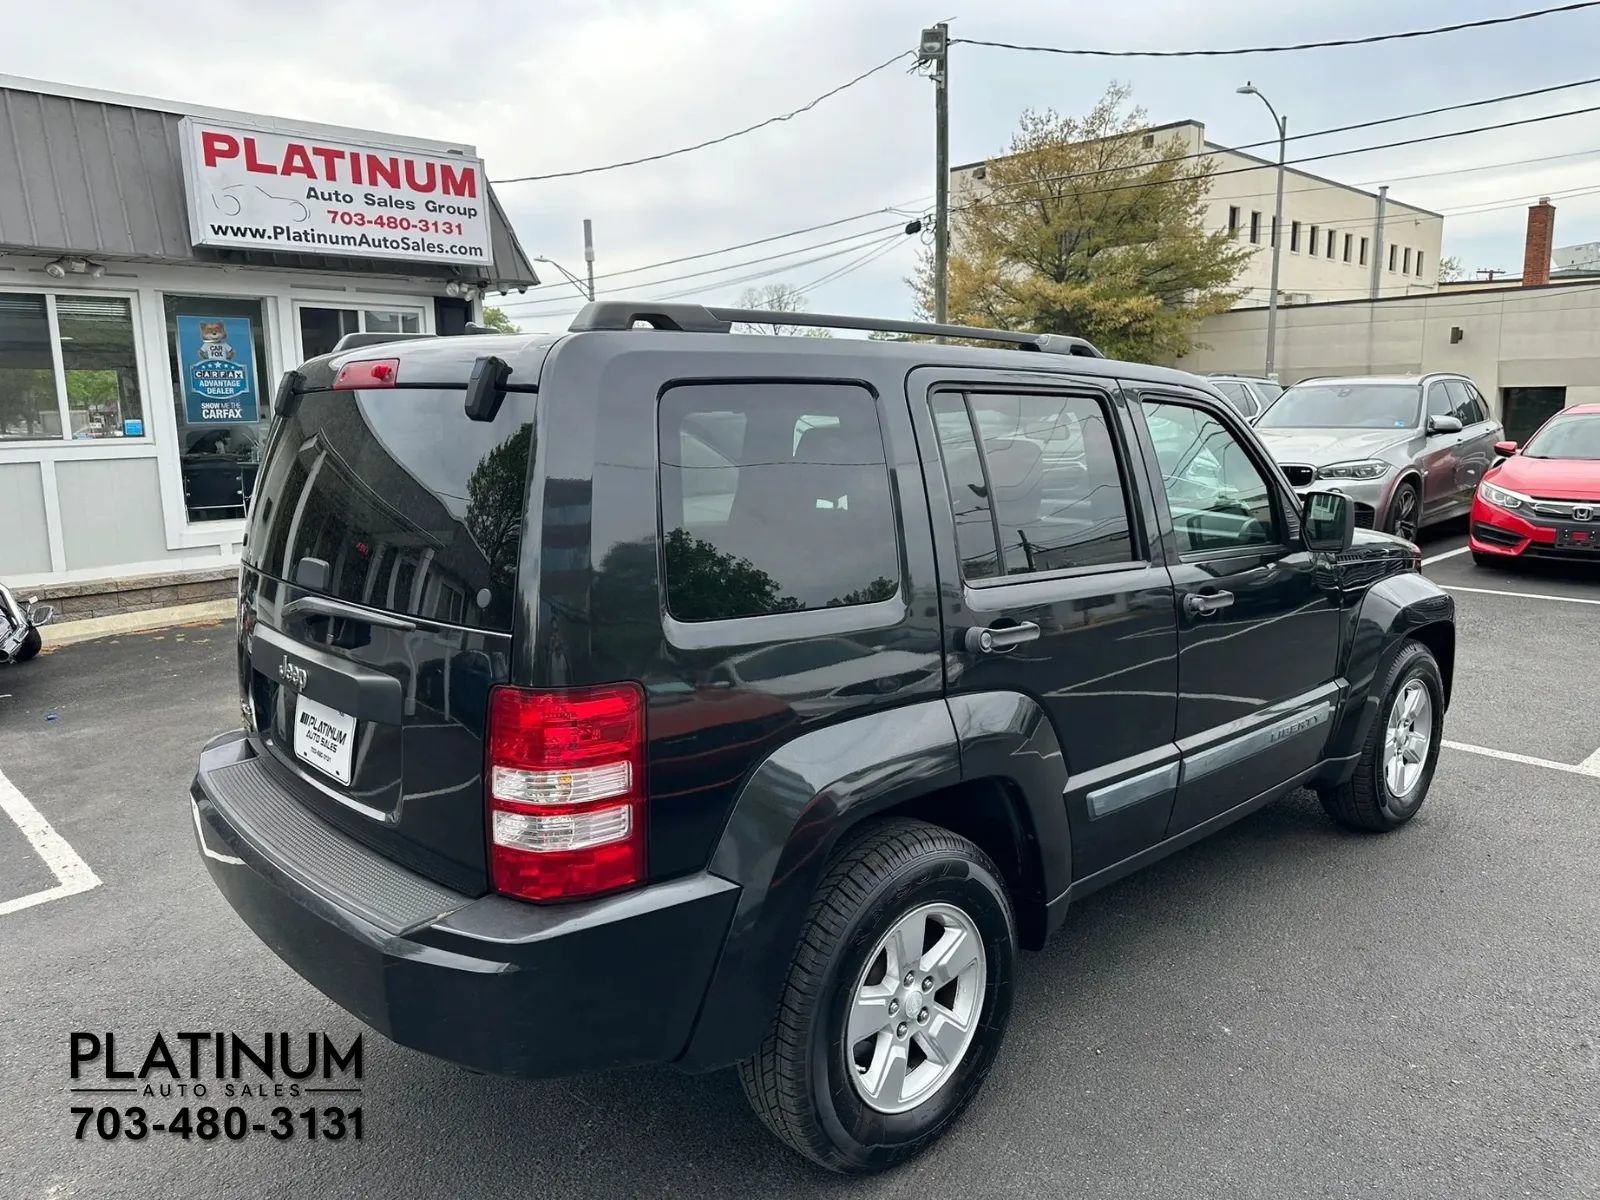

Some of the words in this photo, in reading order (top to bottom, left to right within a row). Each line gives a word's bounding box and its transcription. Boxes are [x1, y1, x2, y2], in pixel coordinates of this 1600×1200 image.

[201, 131, 477, 199] PLATINUM
[306, 187, 354, 204] Auto
[364, 193, 415, 211] Sales
[425, 200, 478, 218] Group
[326, 210, 464, 236] 703-480-3131
[210, 223, 483, 257] www.PlatinumAutoSales.com
[195, 370, 243, 379] CARFAX
[199, 379, 241, 387] ADVANTAGE
[206, 387, 235, 395] DEALER
[202, 408, 242, 419] CARFAX
[279, 655, 307, 692] Jeep
[308, 716, 347, 746] PLATINUM
[1270, 713, 1322, 742] LIBERTY
[306, 730, 321, 744] AUTO
[320, 737, 338, 754] SALES
